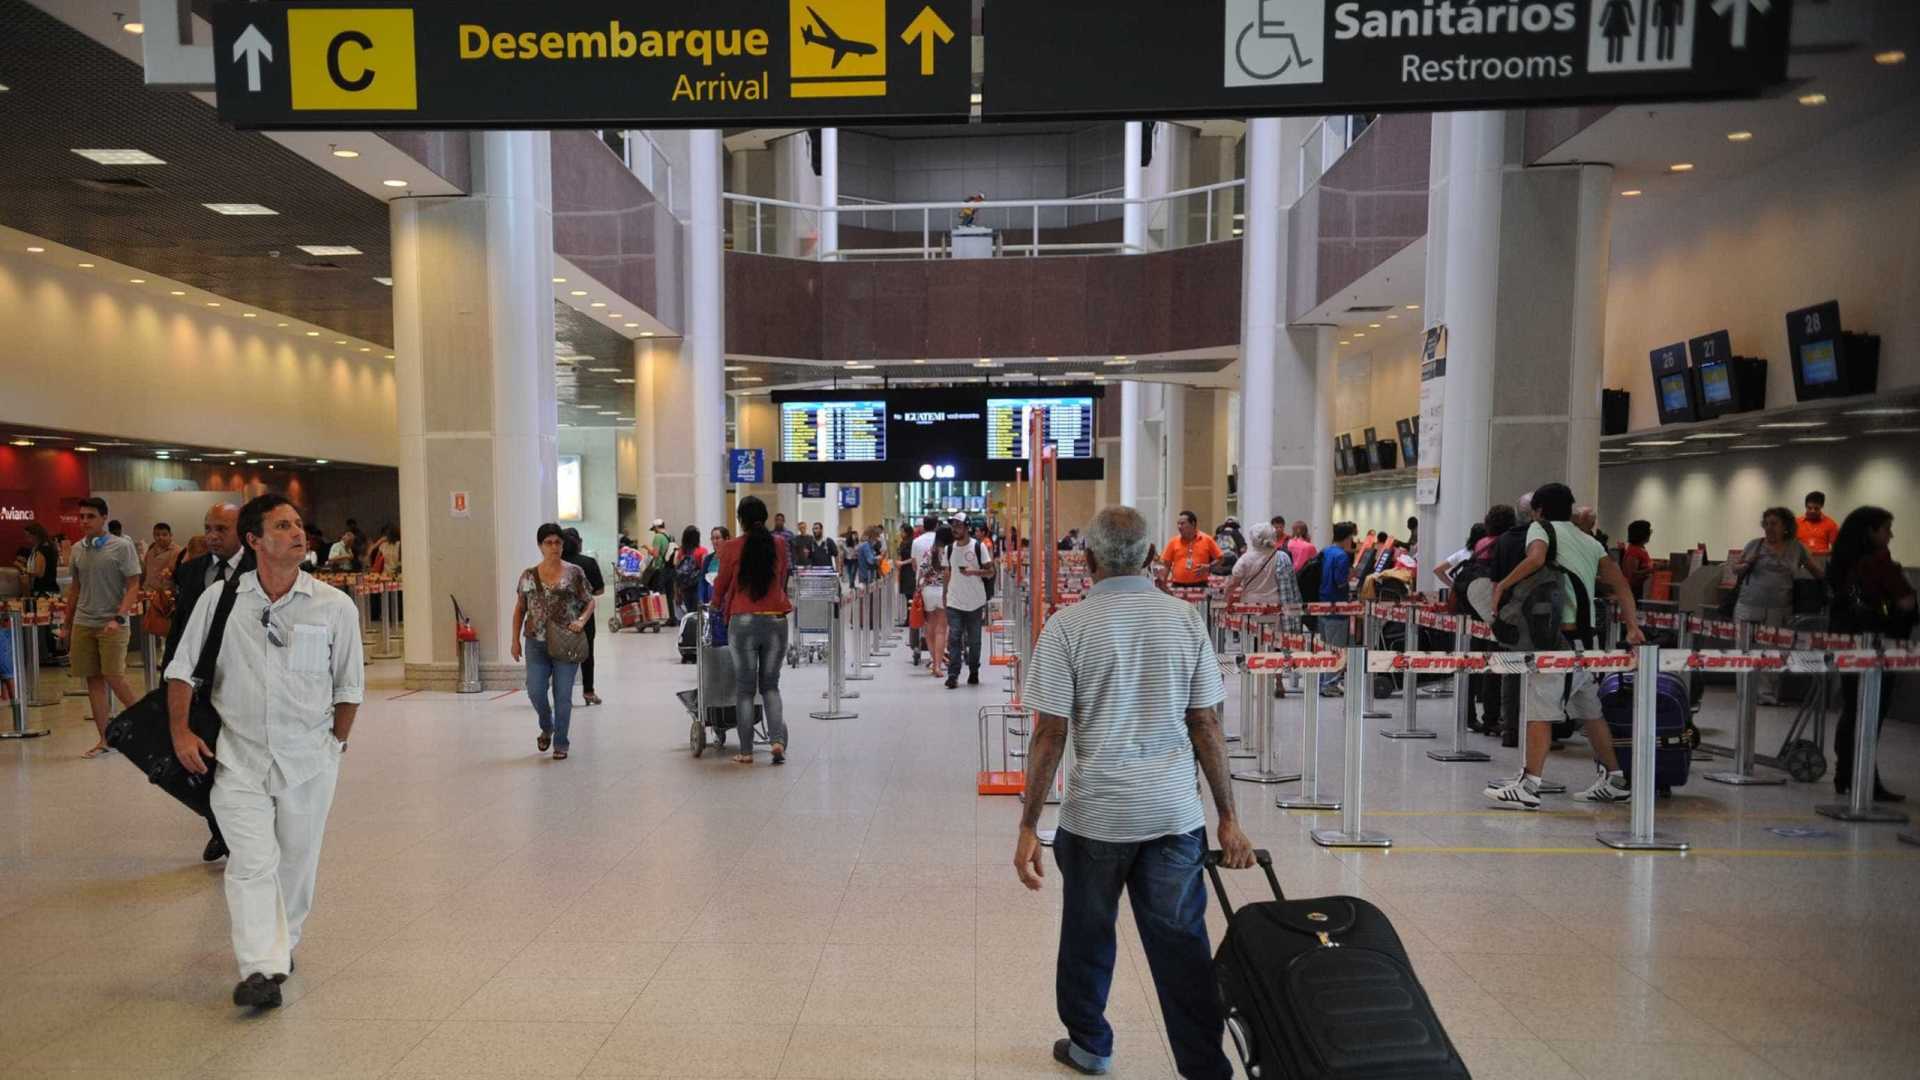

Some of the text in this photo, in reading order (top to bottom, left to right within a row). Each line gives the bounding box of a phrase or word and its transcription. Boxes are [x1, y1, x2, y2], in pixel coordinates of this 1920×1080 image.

[1334, 0, 1576, 39] Sanitários
[460, 20, 769, 65] Desembarque
[327, 31, 375, 92] C
[1402, 53, 1573, 82] Restrooms
[672, 71, 769, 101] Arrival
[1804, 312, 1822, 334] 28
[1703, 340, 1716, 358] 27
[904, 412, 945, 421] IGUATEMI
[936, 464, 955, 478] LG
[0, 506, 34, 520] Avianca
